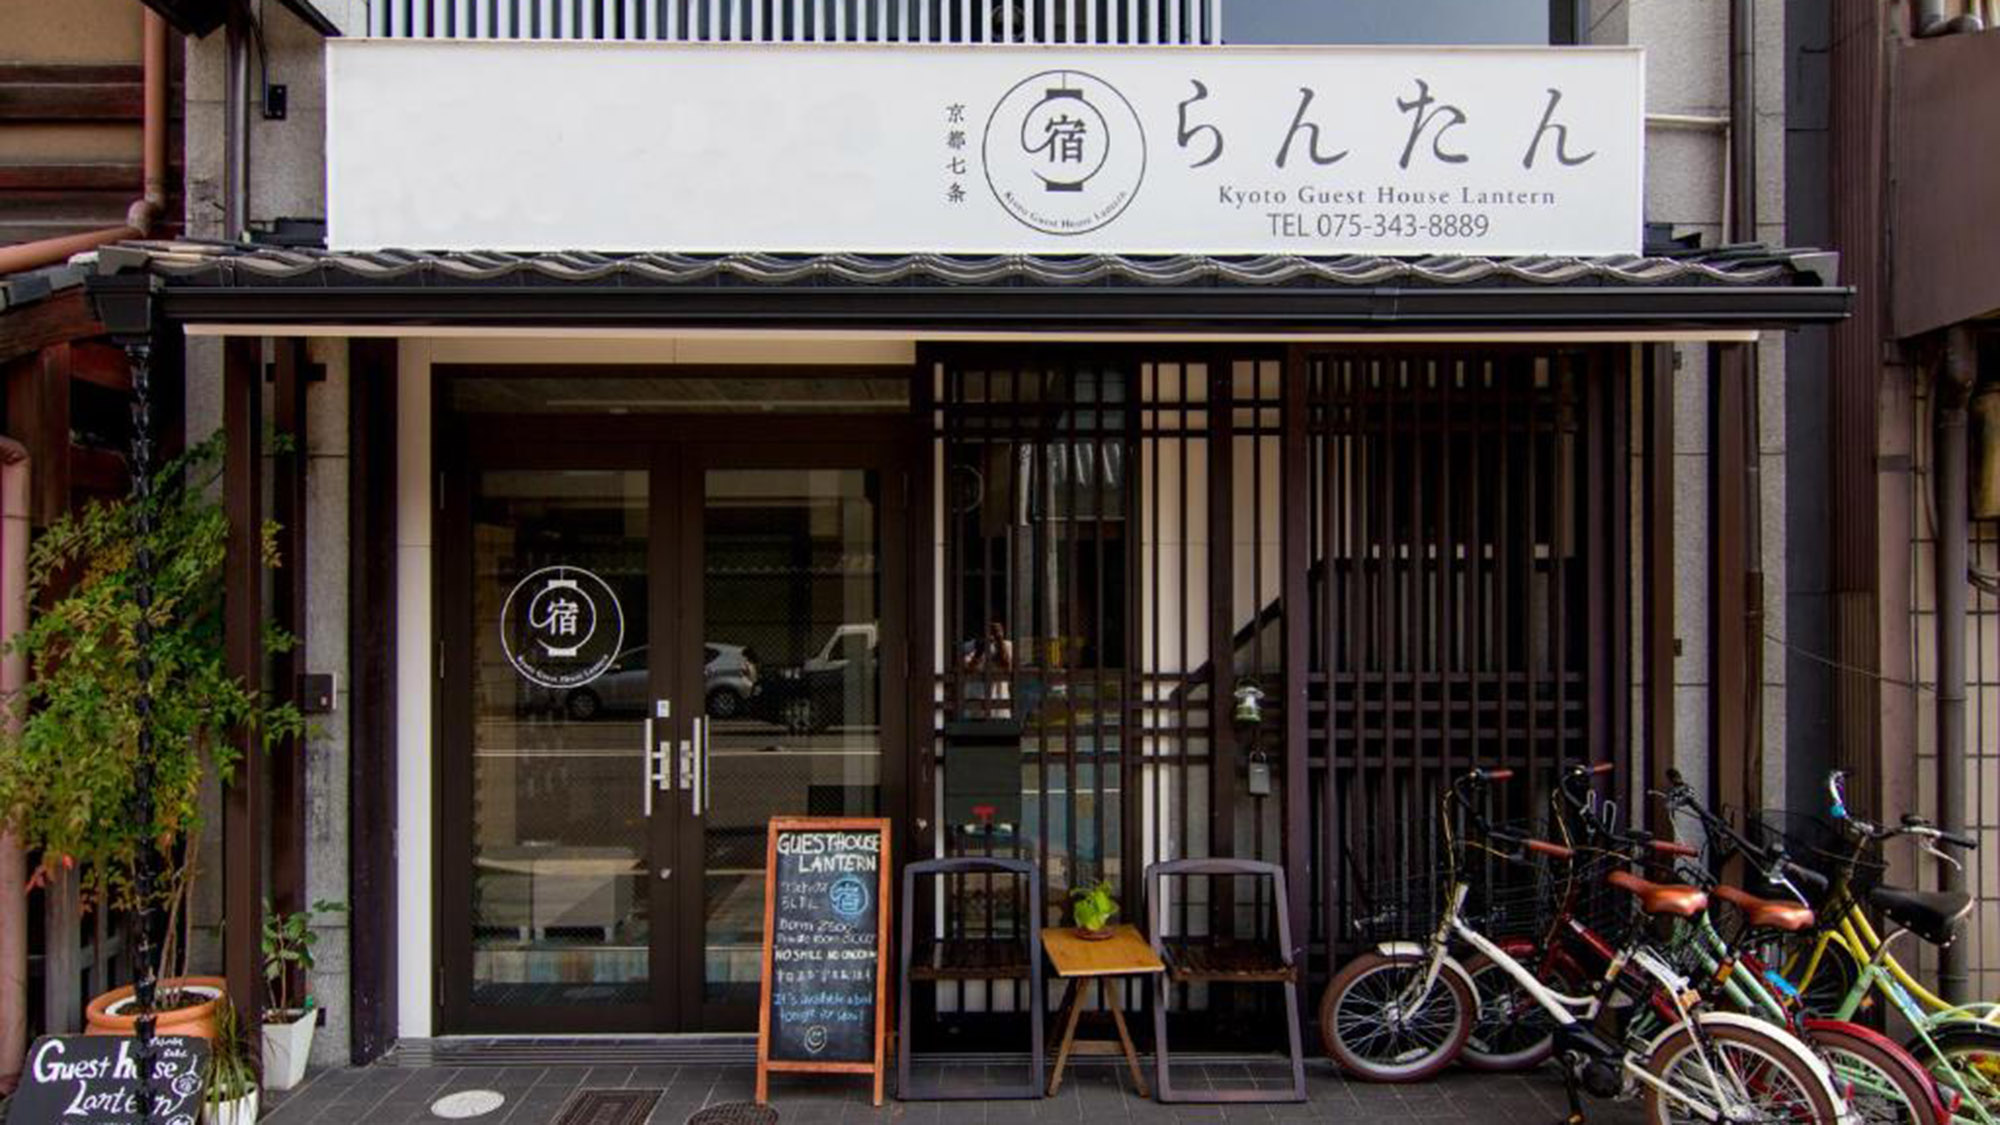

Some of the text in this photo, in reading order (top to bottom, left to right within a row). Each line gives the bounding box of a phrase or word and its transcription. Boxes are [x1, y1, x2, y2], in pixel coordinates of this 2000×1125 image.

[1044, 114, 1087, 163] 宿
[1177, 78, 1597, 169] らんたん
[946, 102, 966, 203] 京都七条
[1218, 185, 1556, 209] Kyoto Guest House Lantern
[1266, 213, 1490, 238] TEL 075-343-8889
[547, 598, 579, 635] 宿
[798, 853, 876, 873] LANTERN
[33, 1039, 177, 1083] Guest hse
[63, 1080, 173, 1116] Lanten
